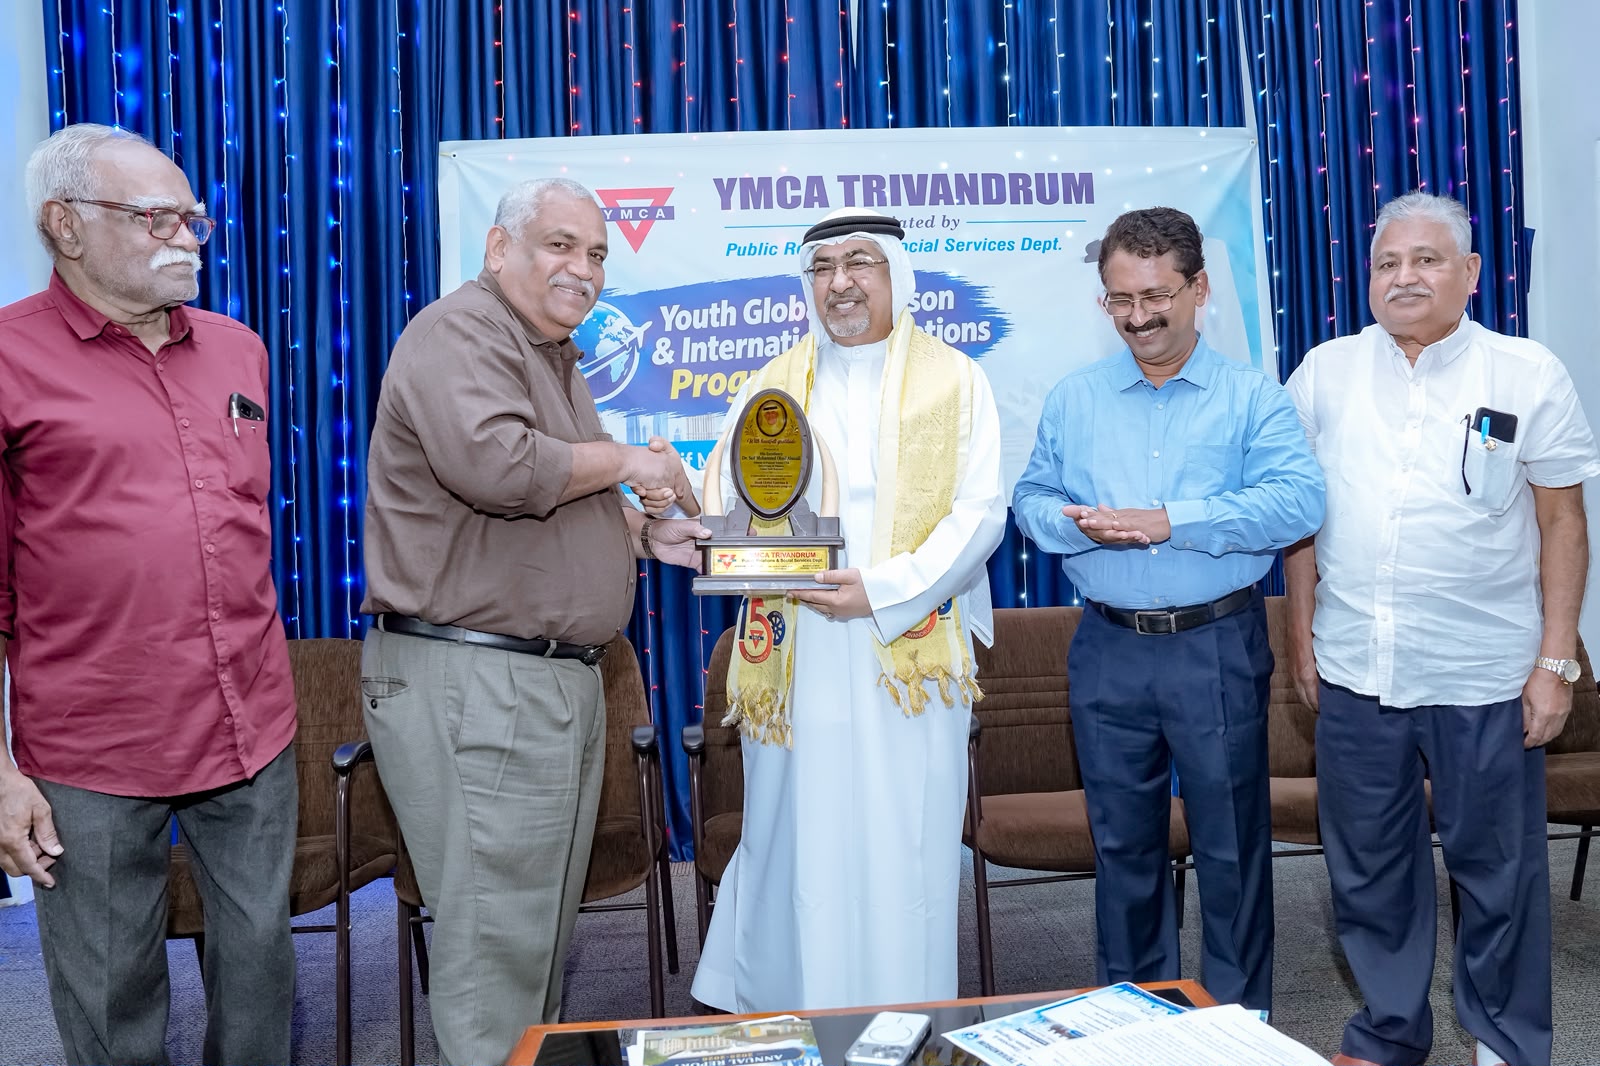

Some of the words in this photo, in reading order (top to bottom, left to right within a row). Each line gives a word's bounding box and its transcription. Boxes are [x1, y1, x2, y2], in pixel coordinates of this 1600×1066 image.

[712, 175, 830, 210] YMCA
[837, 172, 1095, 207] TRIVANDRUM
[603, 208, 666, 220] YMCA
[941, 215, 960, 230] by
[725, 242, 778, 257] Public
[901, 239, 939, 252] ocial
[944, 237, 1015, 252] Services
[1021, 237, 1062, 253] Dept.
[908, 289, 954, 313] son
[660, 299, 737, 332] Youth
[743, 295, 809, 325] Glob
[915, 316, 991, 344] tions
[652, 337, 675, 366] &
[681, 327, 801, 364] Internati
